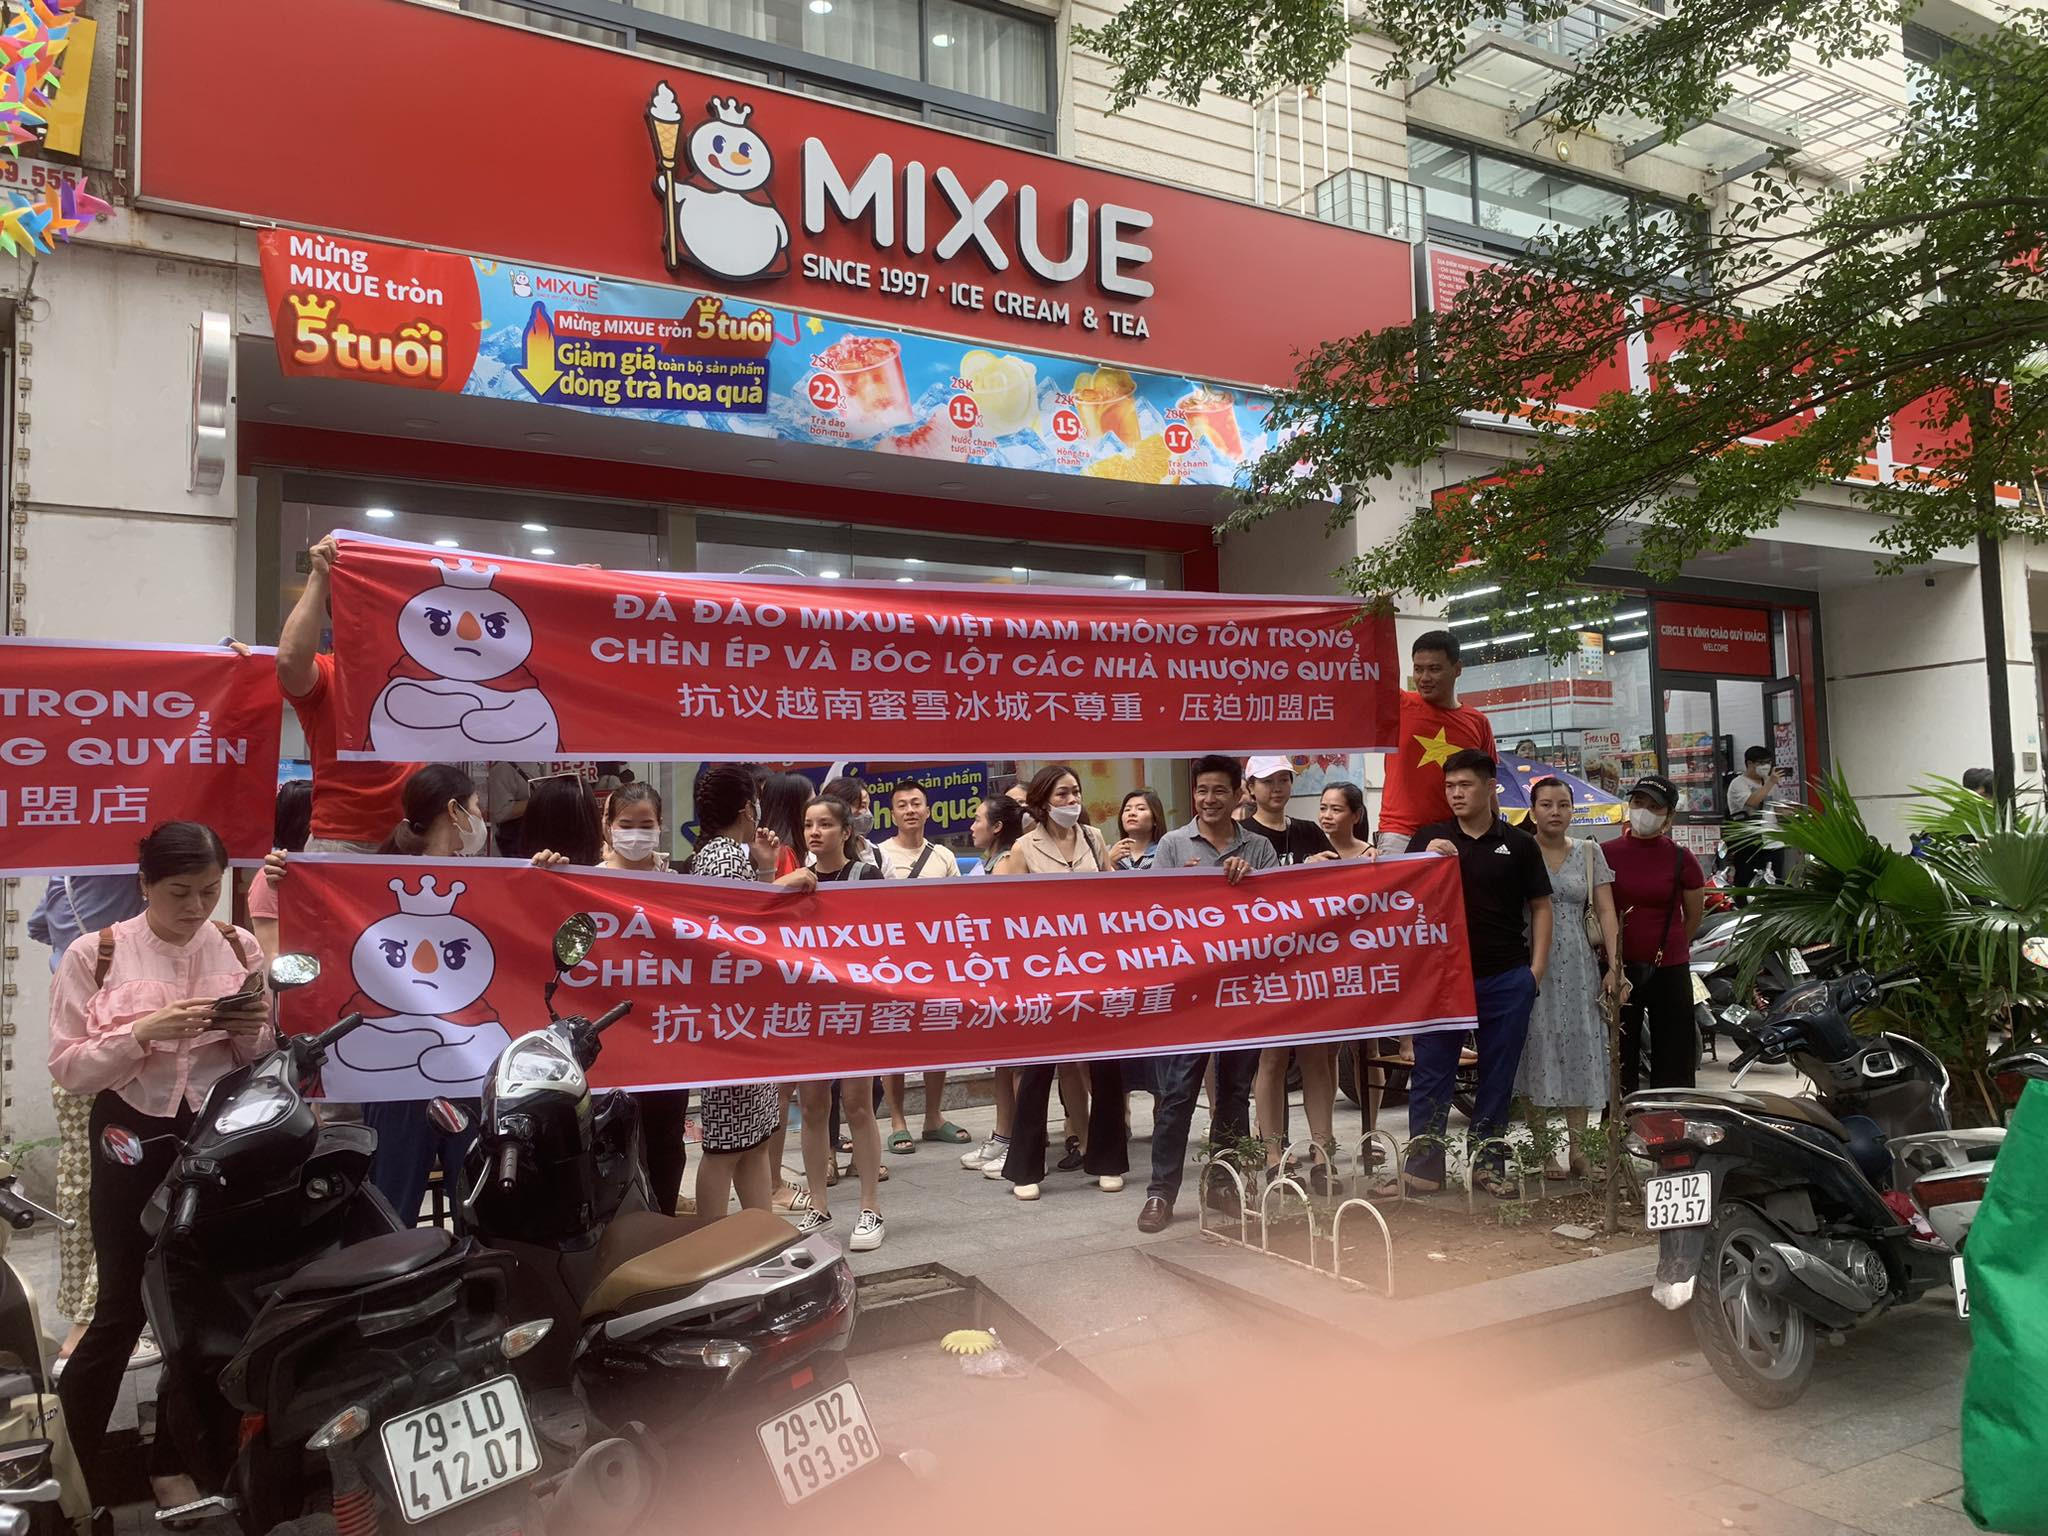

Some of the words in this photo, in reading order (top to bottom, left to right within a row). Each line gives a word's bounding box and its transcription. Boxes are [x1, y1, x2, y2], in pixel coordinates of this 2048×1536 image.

[0, 160, 76, 191] 9.555
[804, 136, 1155, 299] MIXUE
[290, 235, 368, 273] Mừng
[290, 264, 379, 297] MIXUE
[385, 278, 442, 305] tròn
[536, 276, 598, 300] MIXUE
[803, 253, 871, 288] SINCE
[880, 267, 930, 298] 1997
[951, 282, 984, 309] ICE
[995, 290, 1070, 325] CREAM
[1083, 306, 1099, 331] &
[1110, 311, 1150, 338] TEA
[559, 314, 600, 337] Mừng
[604, 318, 654, 336] MIXUE
[658, 320, 692, 338] tròn
[558, 343, 615, 369] Giảm
[621, 346, 656, 375] giá
[657, 359, 685, 372] toàn
[688, 361, 703, 376] bộ
[706, 362, 727, 374] sản
[730, 362, 765, 376] phẩm
[559, 367, 621, 404] dòng
[625, 371, 662, 399] trà
[667, 376, 711, 402] hoa
[716, 377, 763, 408] quả
[974, 438, 997, 448] chanh
[1183, 460, 1208, 468] chanh
[800, 607, 915, 634] MIXUE
[925, 613, 993, 643] VIỆT
[1004, 618, 1079, 641] NAM
[1090, 618, 1199, 645] KHÔNG
[1207, 621, 1259, 647] TÔN
[1661, 625, 1685, 636] CIRCLE
[1687, 627, 1692, 637] K
[591, 632, 709, 666] CHÈN
[725, 636, 770, 668] ÉP
[784, 640, 837, 671] VÀ
[851, 643, 931, 673] BÓC
[944, 647, 1003, 681] LỘT
[1012, 649, 1084, 678] CÁC
[1094, 652, 1158, 679] NHÀ
[1168, 657, 1289, 685] NHƯỢNG
[1703, 643, 1728, 652] WELCOME
[866, 778, 894, 794] oàn
[944, 768, 982, 789] phẩm
[0, 785, 150, 827] 盟店
[931, 786, 981, 828] quả
[672, 915, 767, 945] ĐẢO
[779, 922, 905, 948] MIXUE
[916, 913, 992, 948] VIỆT
[1004, 914, 1087, 940] NAM
[1098, 903, 1225, 934] KHÔNG
[1232, 897, 1306, 923] TÔN
[560, 950, 693, 988] CHÈN
[710, 951, 763, 984] ÉP
[776, 956, 838, 984] VÀ
[847, 956, 935, 984] BÓC
[945, 952, 1011, 988] LỘT
[1023, 946, 1106, 977] CÁC
[1116, 938, 1196, 971] NHÀ
[1203, 931, 1339, 963] NHƯỢNG
[1655, 1176, 1700, 1202] 29-D2
[1650, 1200, 1706, 1227] 332.57
[405, 1390, 505, 1462] 29-LD
[775, 1392, 852, 1457] 29-D2
[409, 1428, 522, 1511] 412.07
[783, 1425, 874, 1497] 193.98
